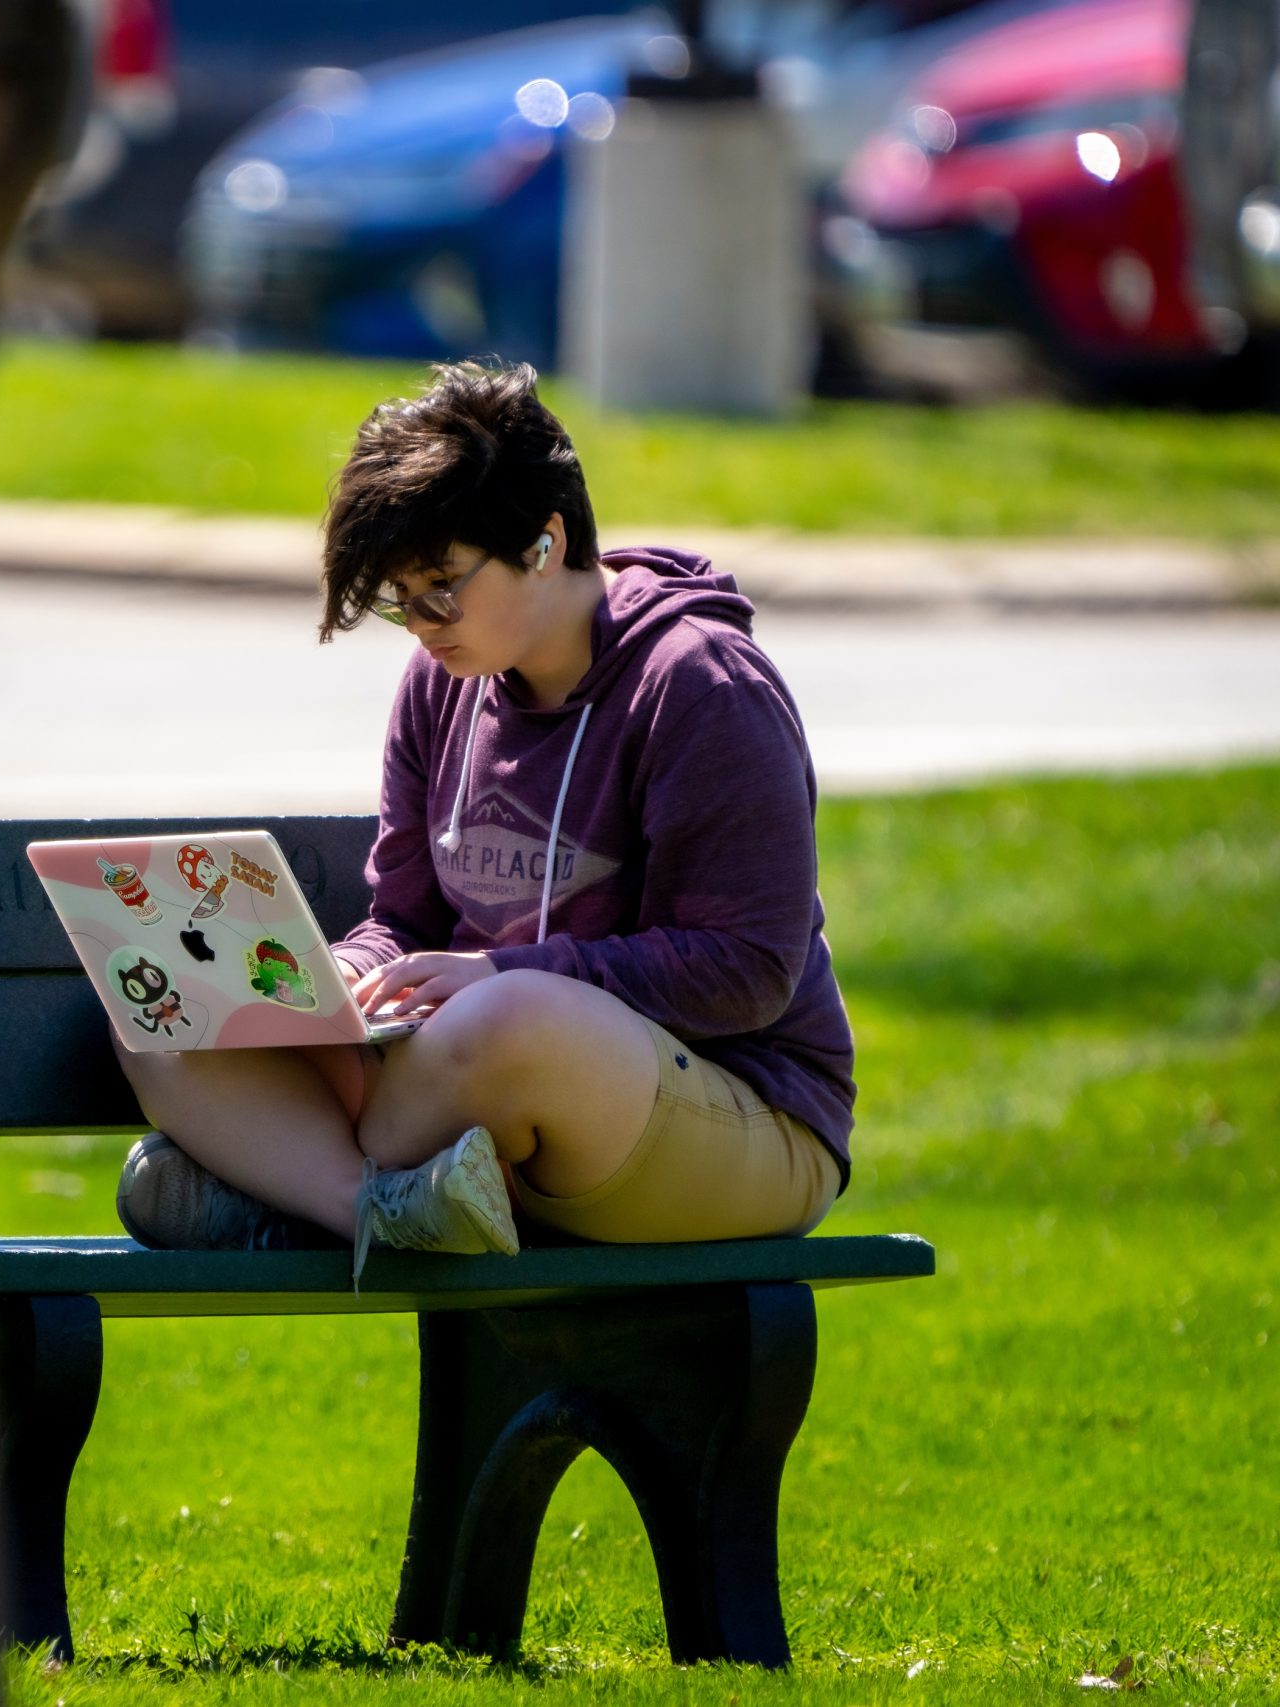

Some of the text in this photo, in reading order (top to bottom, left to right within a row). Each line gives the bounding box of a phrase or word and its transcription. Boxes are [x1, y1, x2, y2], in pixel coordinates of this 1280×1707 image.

[230, 851, 278, 884] TODAY
[480, 846, 575, 882] PLACID
[231, 865, 275, 898] SATAN
